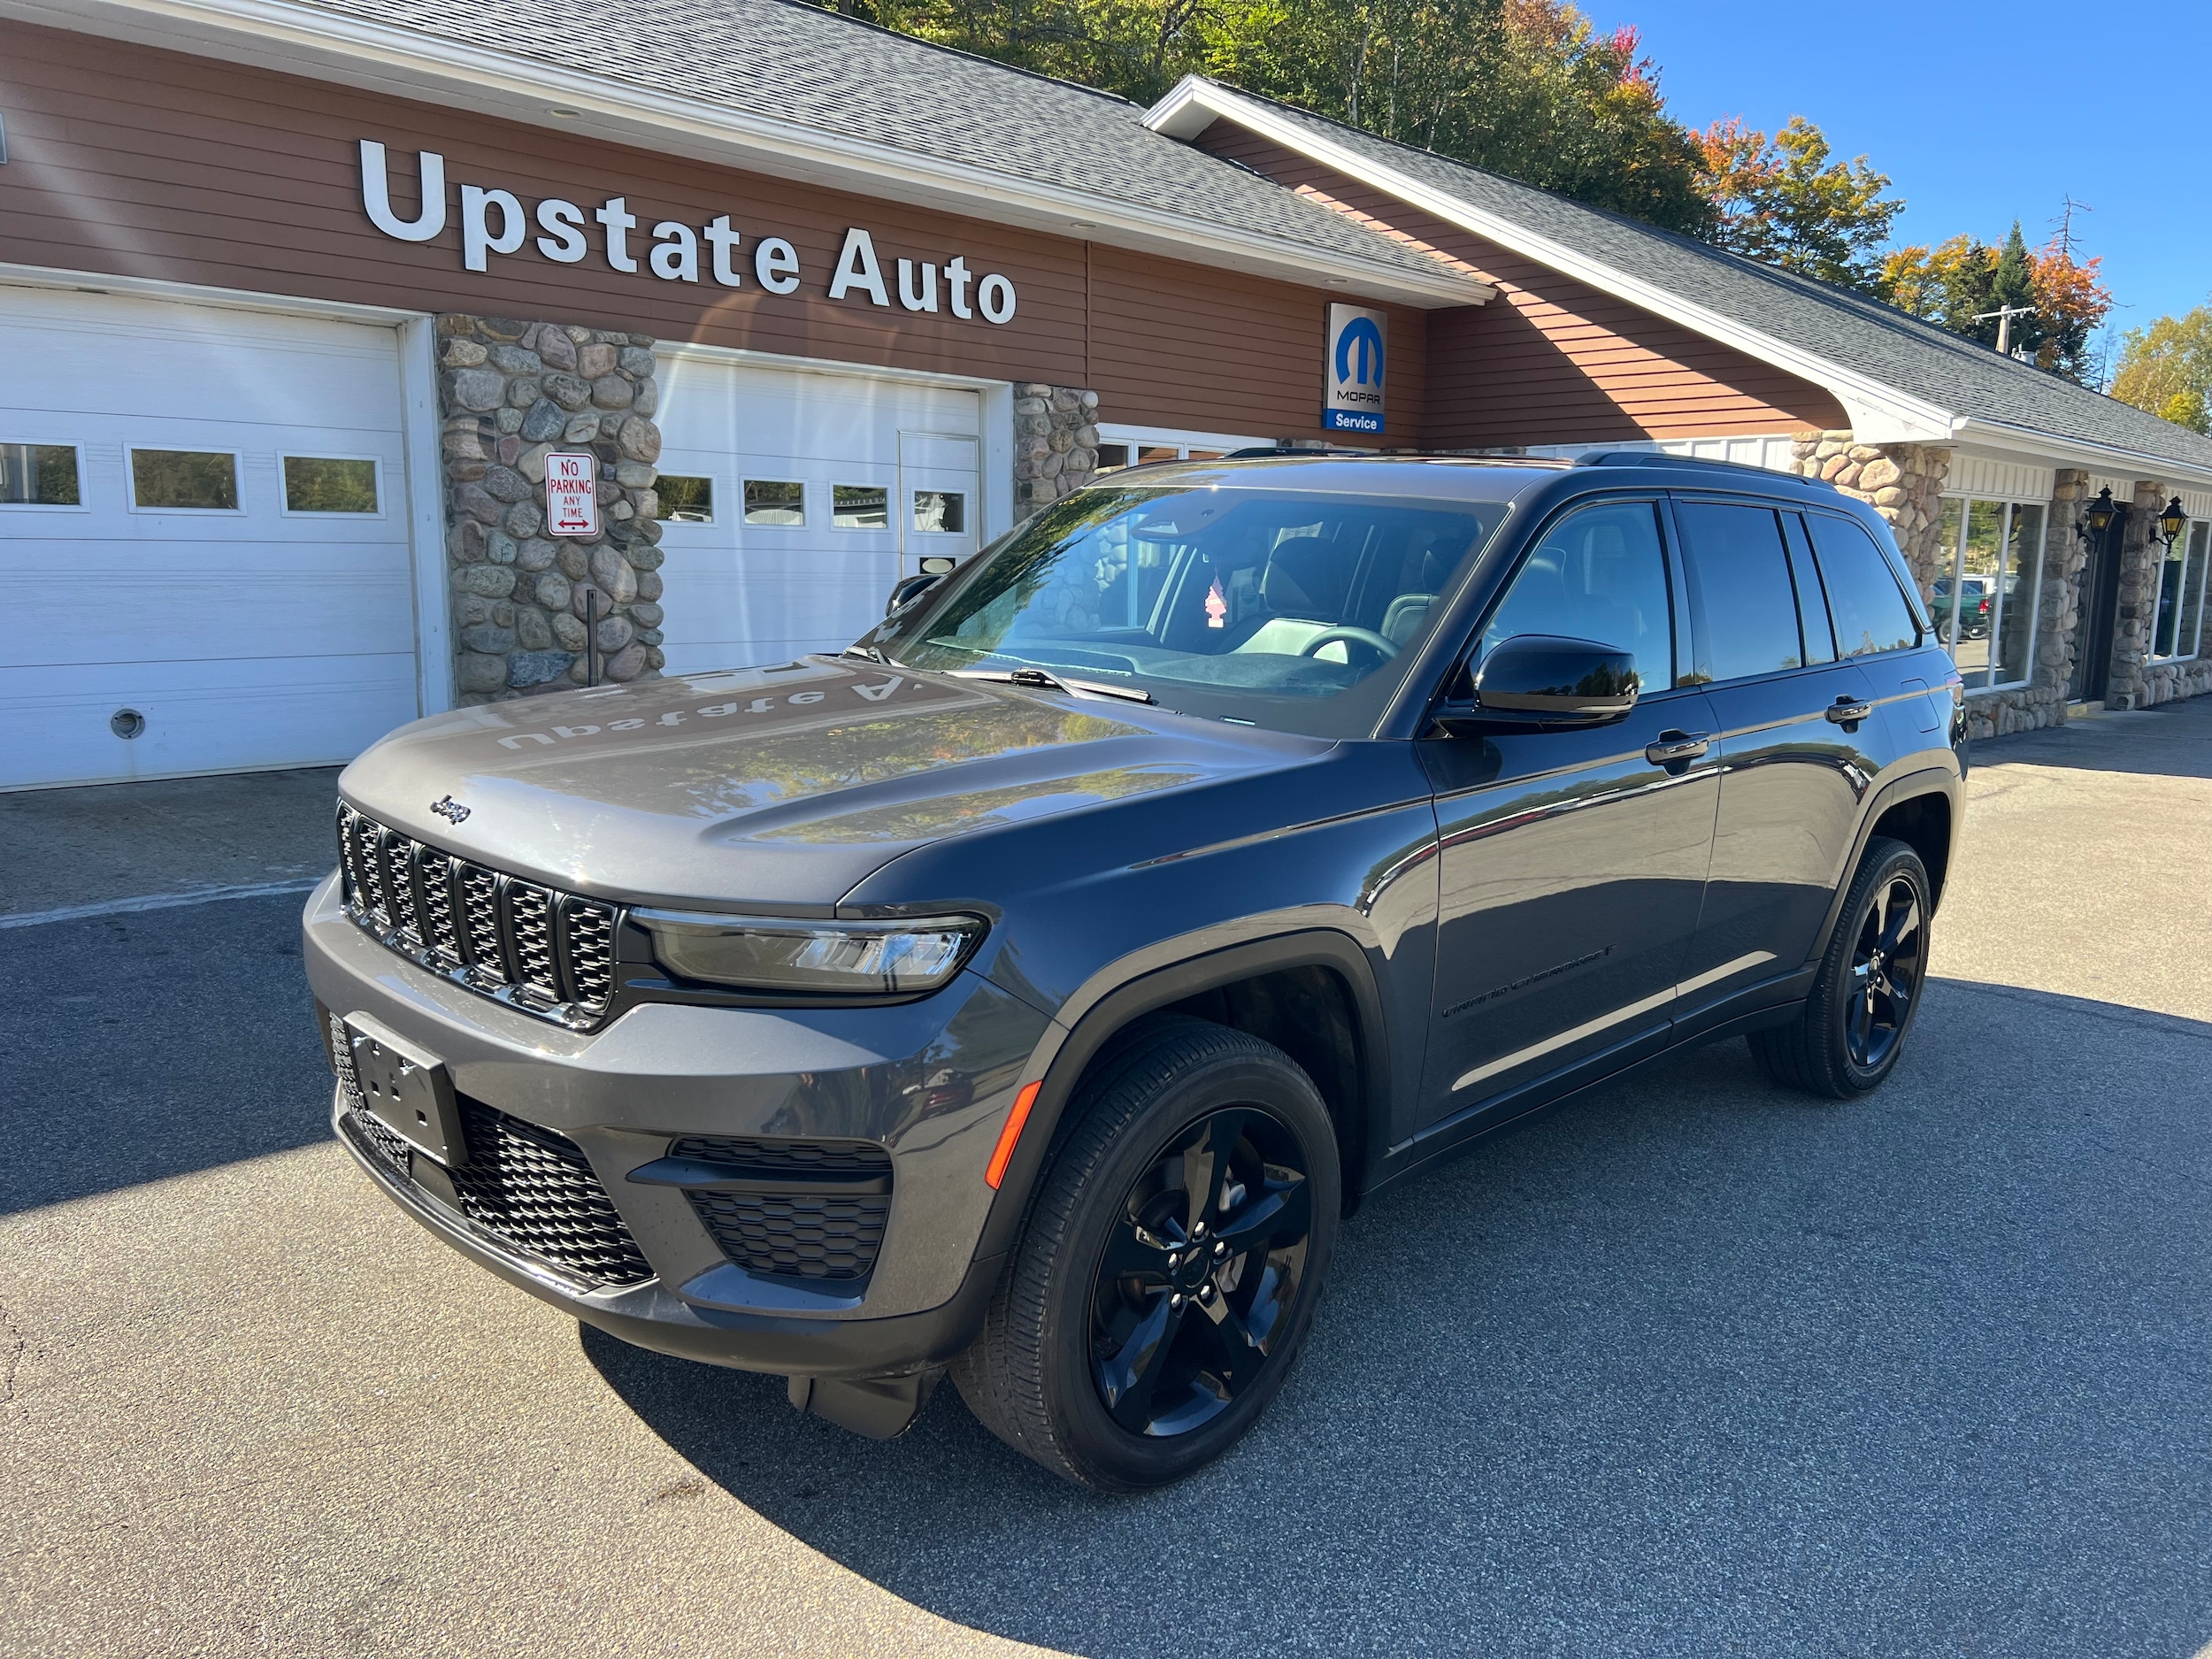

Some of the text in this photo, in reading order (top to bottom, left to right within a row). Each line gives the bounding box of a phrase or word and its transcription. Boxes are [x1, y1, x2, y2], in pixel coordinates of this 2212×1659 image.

[358, 139, 1017, 325] Upstate Auto
[1337, 390, 1380, 404] MOPAR
[1335, 413, 1378, 430] Service
[561, 461, 579, 476] NO
[550, 479, 592, 494] PARKING
[563, 496, 580, 505] ANY
[563, 508, 583, 518] TIME
[430, 794, 472, 826] Jeep
